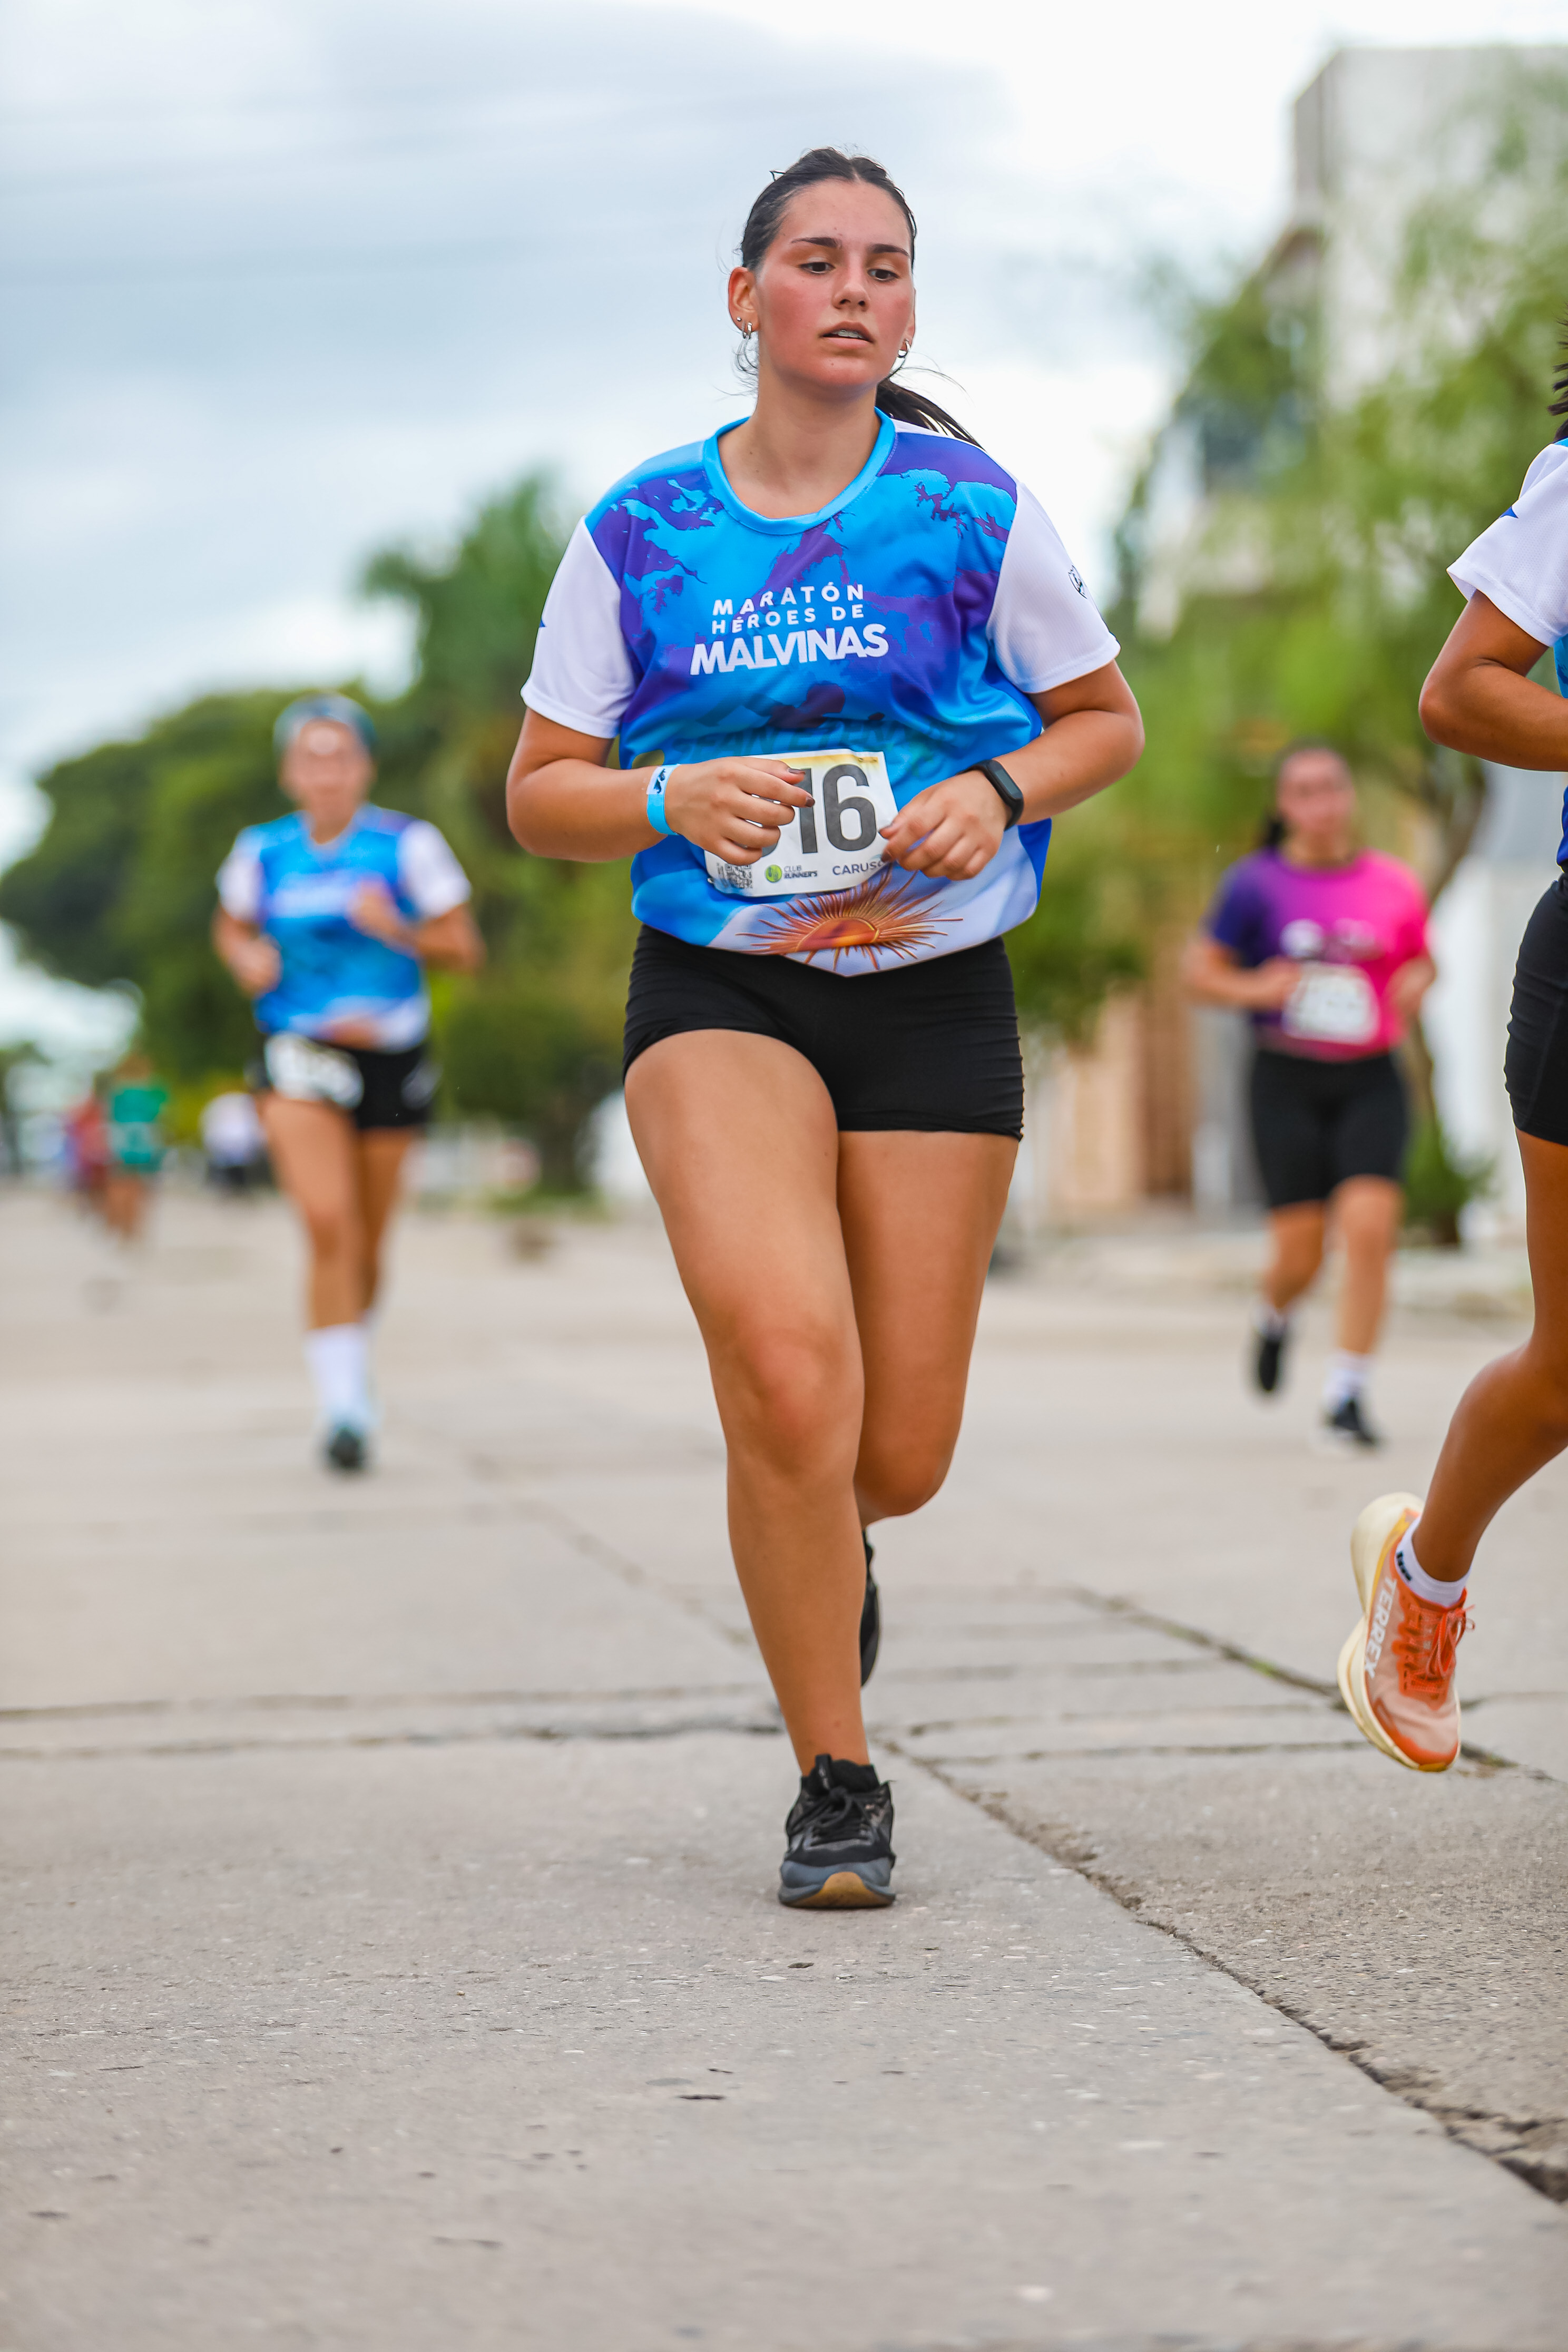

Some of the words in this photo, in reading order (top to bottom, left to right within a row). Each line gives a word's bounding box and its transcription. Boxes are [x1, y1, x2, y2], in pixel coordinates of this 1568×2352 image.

[711, 607, 816, 634] HÉROES
[831, 604, 864, 621] DE
[712, 582, 864, 615] MARATÓN
[690, 623, 889, 675] MALVINAS
[762, 763, 877, 858] 16
[1365, 1577, 1397, 1679] TERREX
